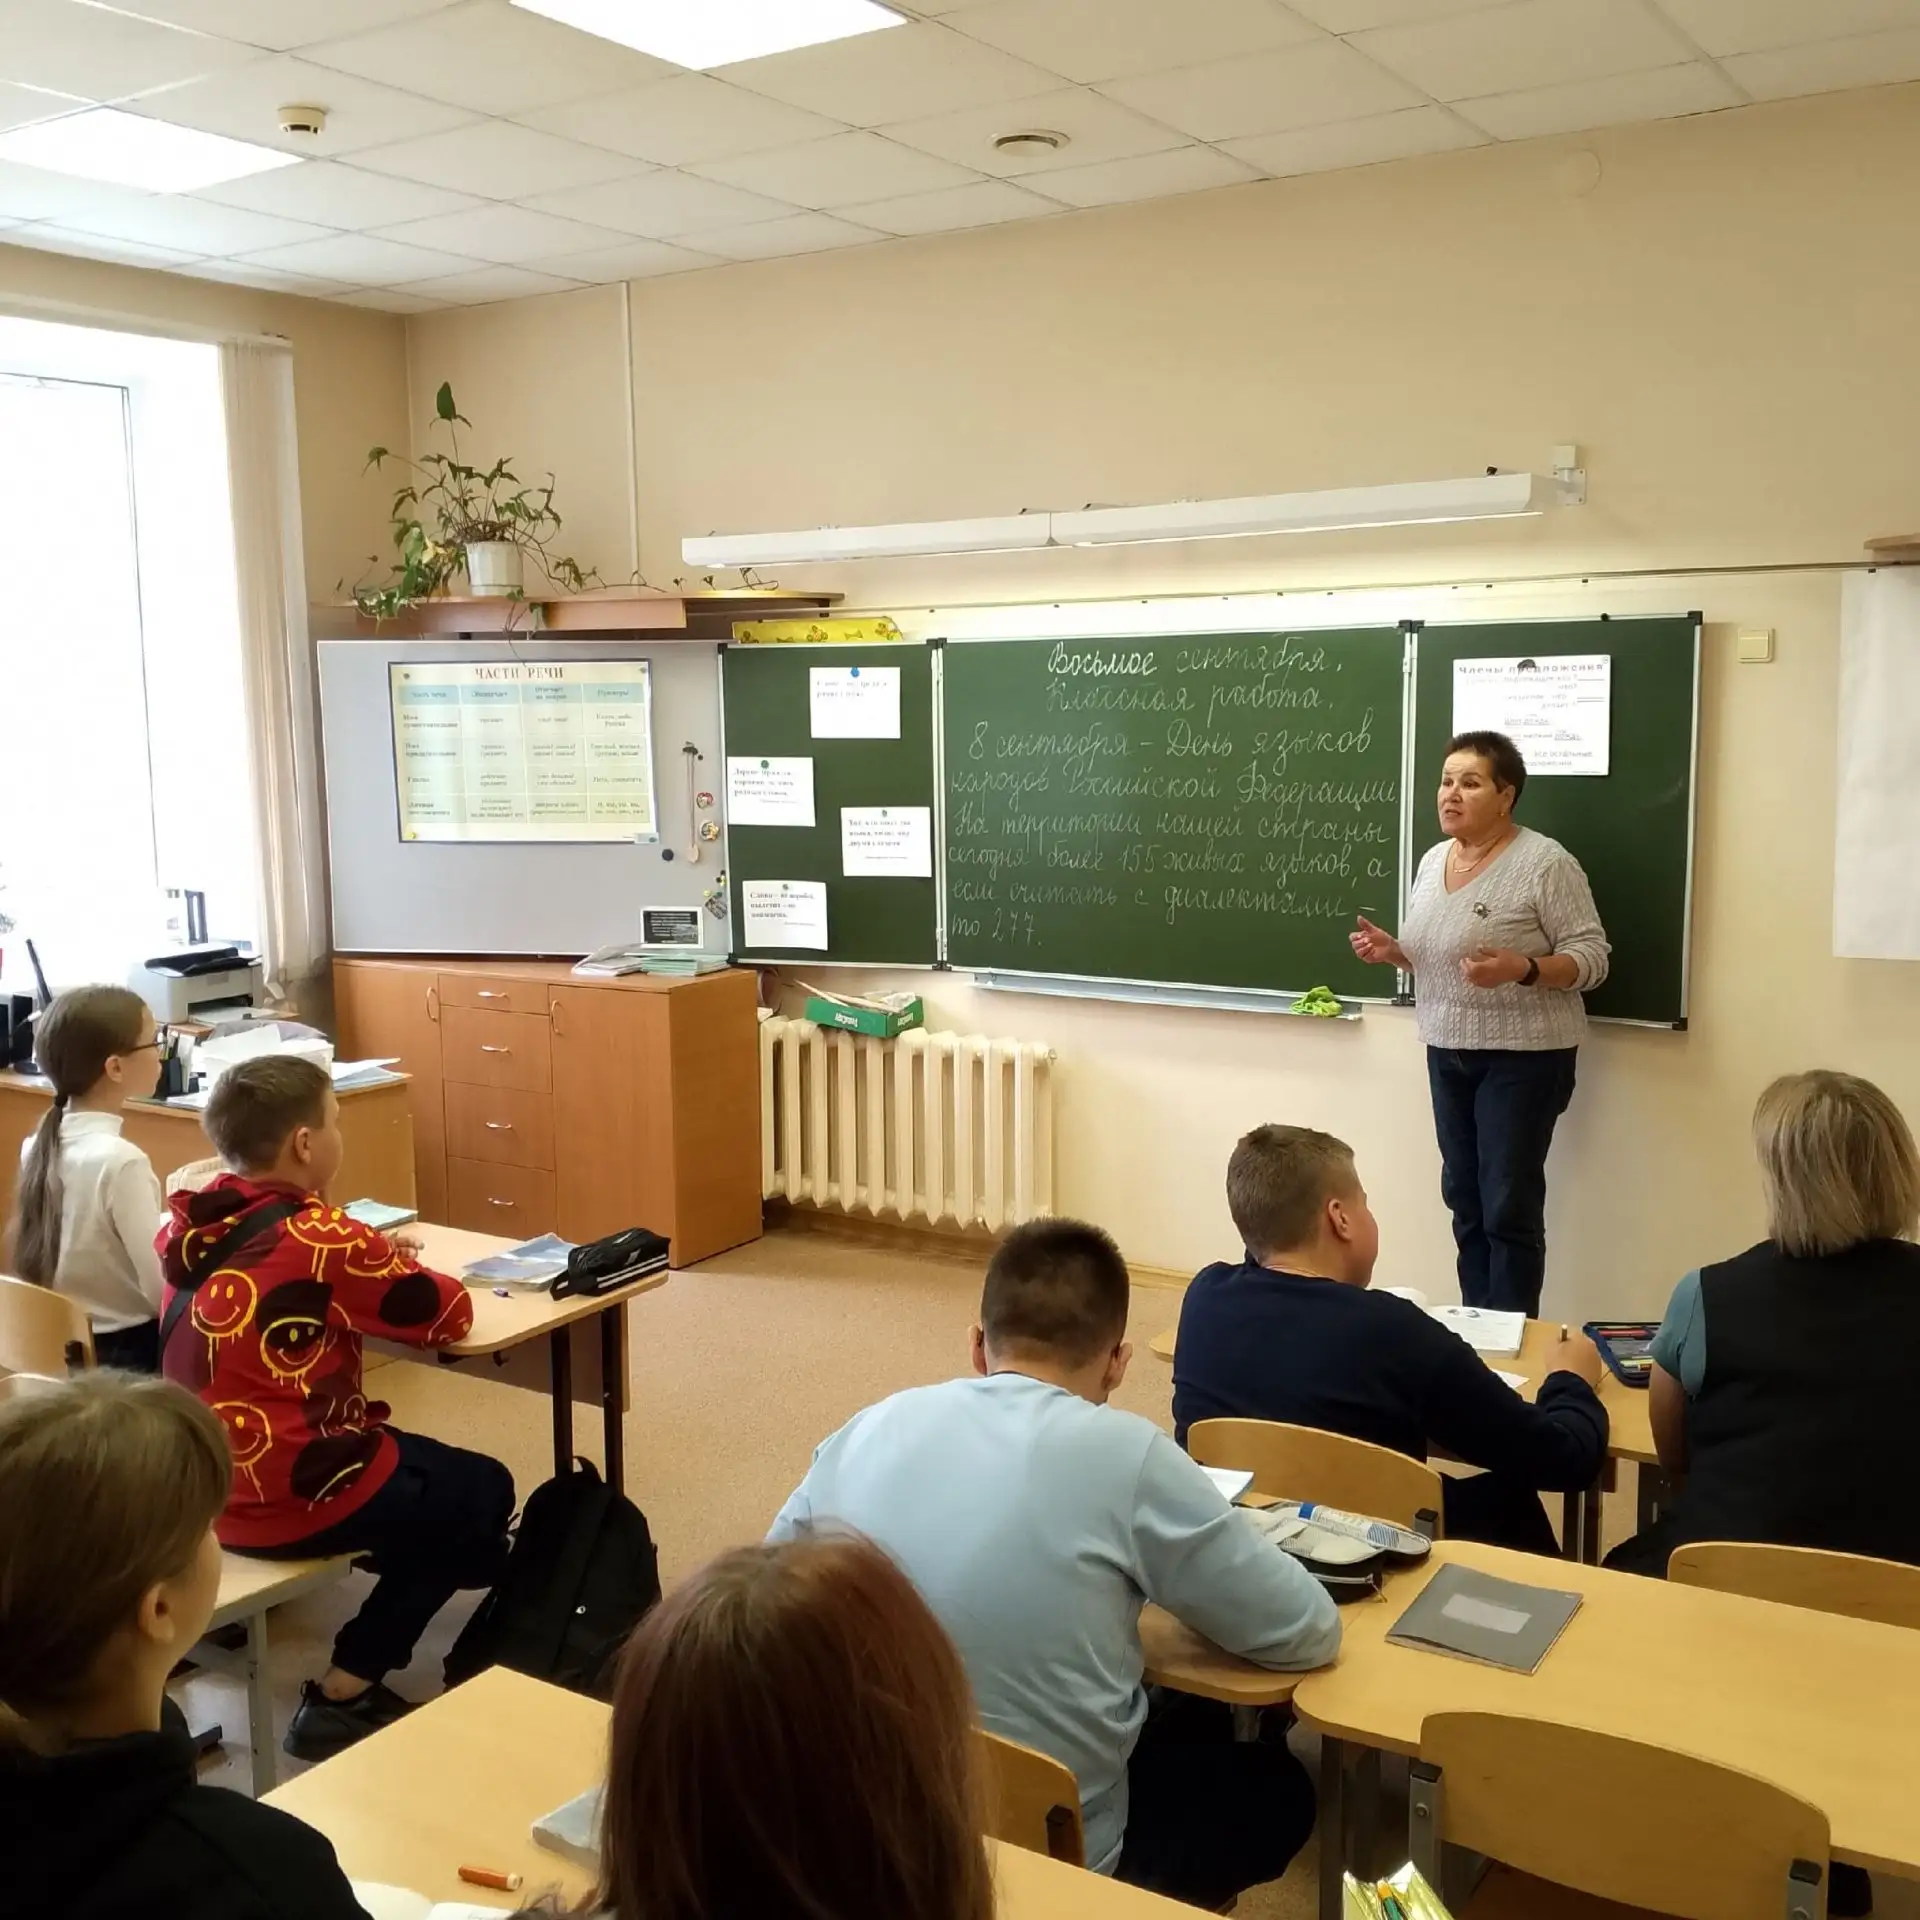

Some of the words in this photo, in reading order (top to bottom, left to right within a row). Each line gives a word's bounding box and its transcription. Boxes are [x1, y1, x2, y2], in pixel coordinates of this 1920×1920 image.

[475, 667, 519, 680] ЧАСТИ
[528, 666, 564, 679] РЕЧИ
[1048, 640, 1157, 677] Восьмое
[1045, 677, 1195, 712] Классная
[969, 720, 988, 760] 8
[996, 722, 1129, 772] сентября
[1166, 717, 1233, 757] День
[1251, 707, 1374, 776] языков
[951, 762, 1050, 816] народов
[1063, 754, 1222, 798] Российской
[953, 801, 989, 836] На
[1002, 812, 1142, 855] территории
[1155, 803, 1244, 837] нашей
[1257, 816, 1391, 852] страны
[948, 846, 1031, 881] сегодня
[1046, 840, 1105, 871] более
[1117, 844, 1161, 873] 155
[1163, 838, 1246, 873] живых
[1367, 857, 1391, 878] а
[951, 878, 995, 901] если
[1009, 881, 1119, 906] считать
[1134, 888, 1150, 906] с
[1164, 885, 1351, 925] диалектами
[951, 913, 981, 937] то
